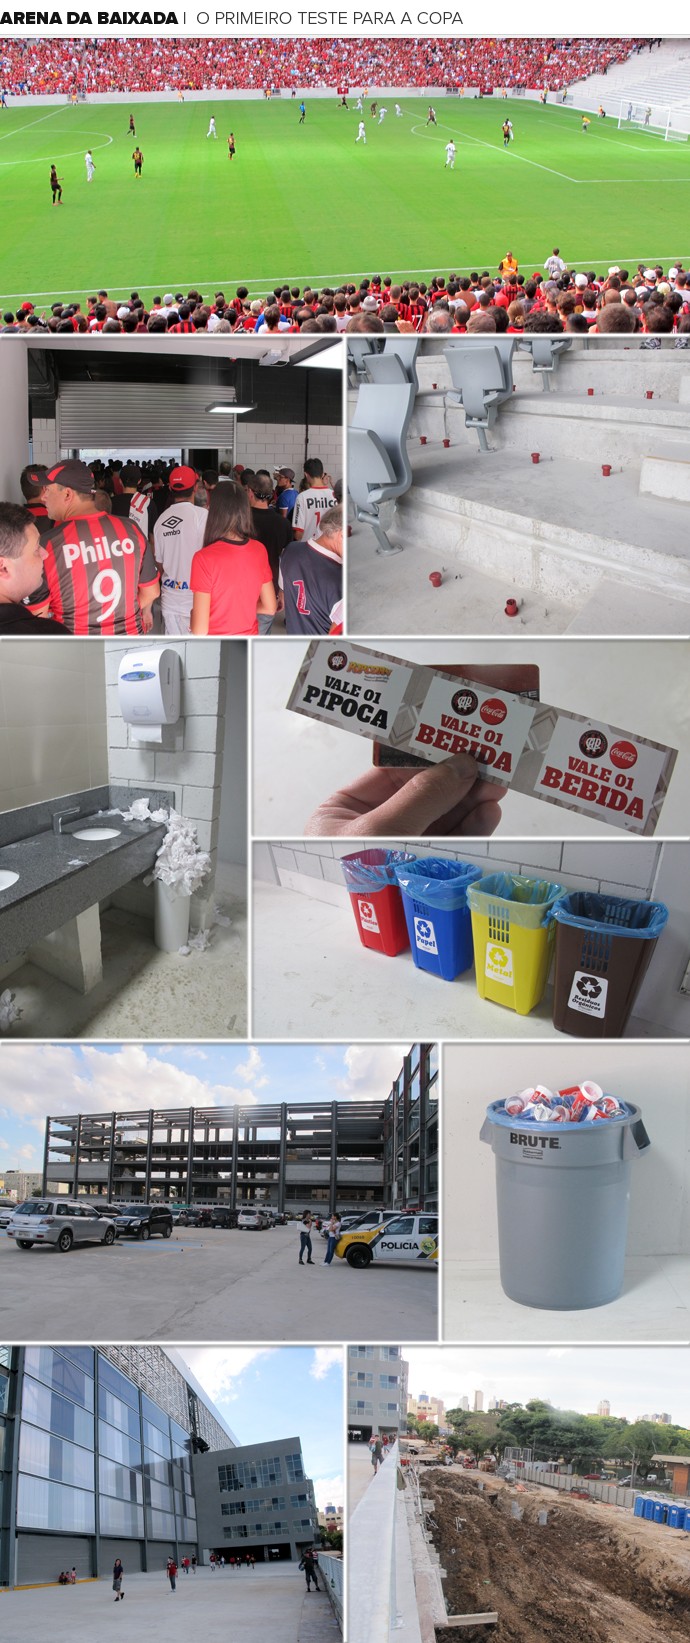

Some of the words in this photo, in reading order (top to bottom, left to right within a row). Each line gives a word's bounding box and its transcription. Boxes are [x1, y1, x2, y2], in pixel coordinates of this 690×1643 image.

[163, 529, 181, 537] umbro
[62, 536, 135, 569] Philco
[92, 568, 122, 622] 9
[324, 675, 362, 697] VALE
[363, 689, 382, 704] 01
[303, 684, 388, 730] PIPOCA
[440, 713, 482, 738] VALE
[483, 729, 504, 746] 01
[415, 723, 512, 773] BEBIDA
[568, 756, 612, 783] VALE
[614, 773, 635, 791] 01
[540, 765, 644, 820] BEBIDA
[417, 935, 436, 948] Papel
[487, 963, 513, 978] Metal
[381, 1241, 419, 1250] POLÍCIA
